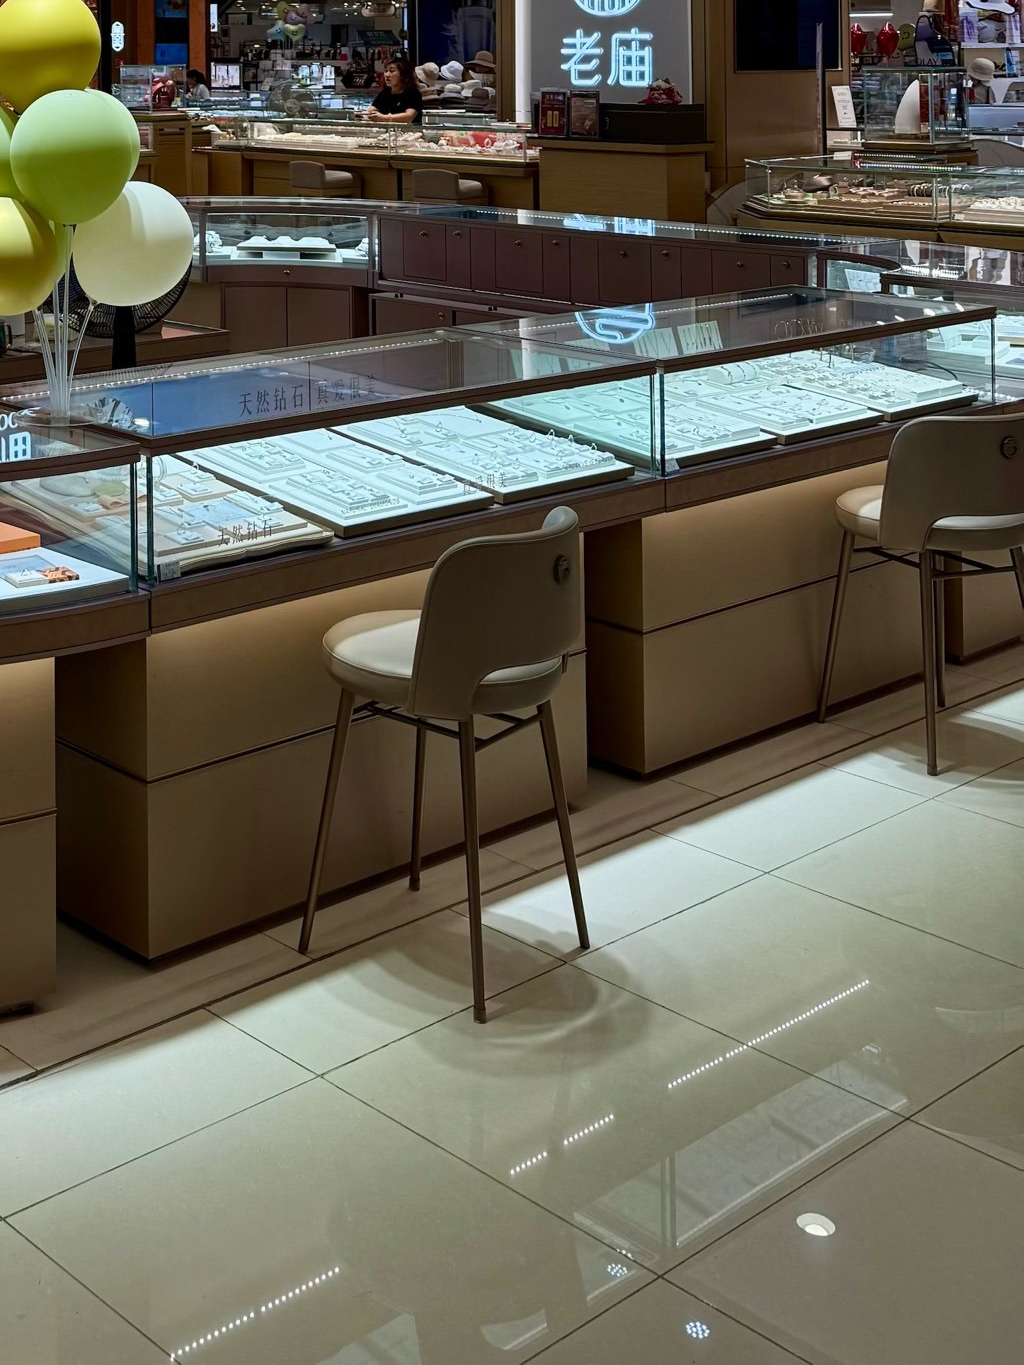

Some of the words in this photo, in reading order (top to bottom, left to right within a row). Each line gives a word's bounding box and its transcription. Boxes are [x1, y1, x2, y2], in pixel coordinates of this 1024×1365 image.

[560, 27, 654, 87] 老庙
[238, 385, 304, 417] 天然钻石
